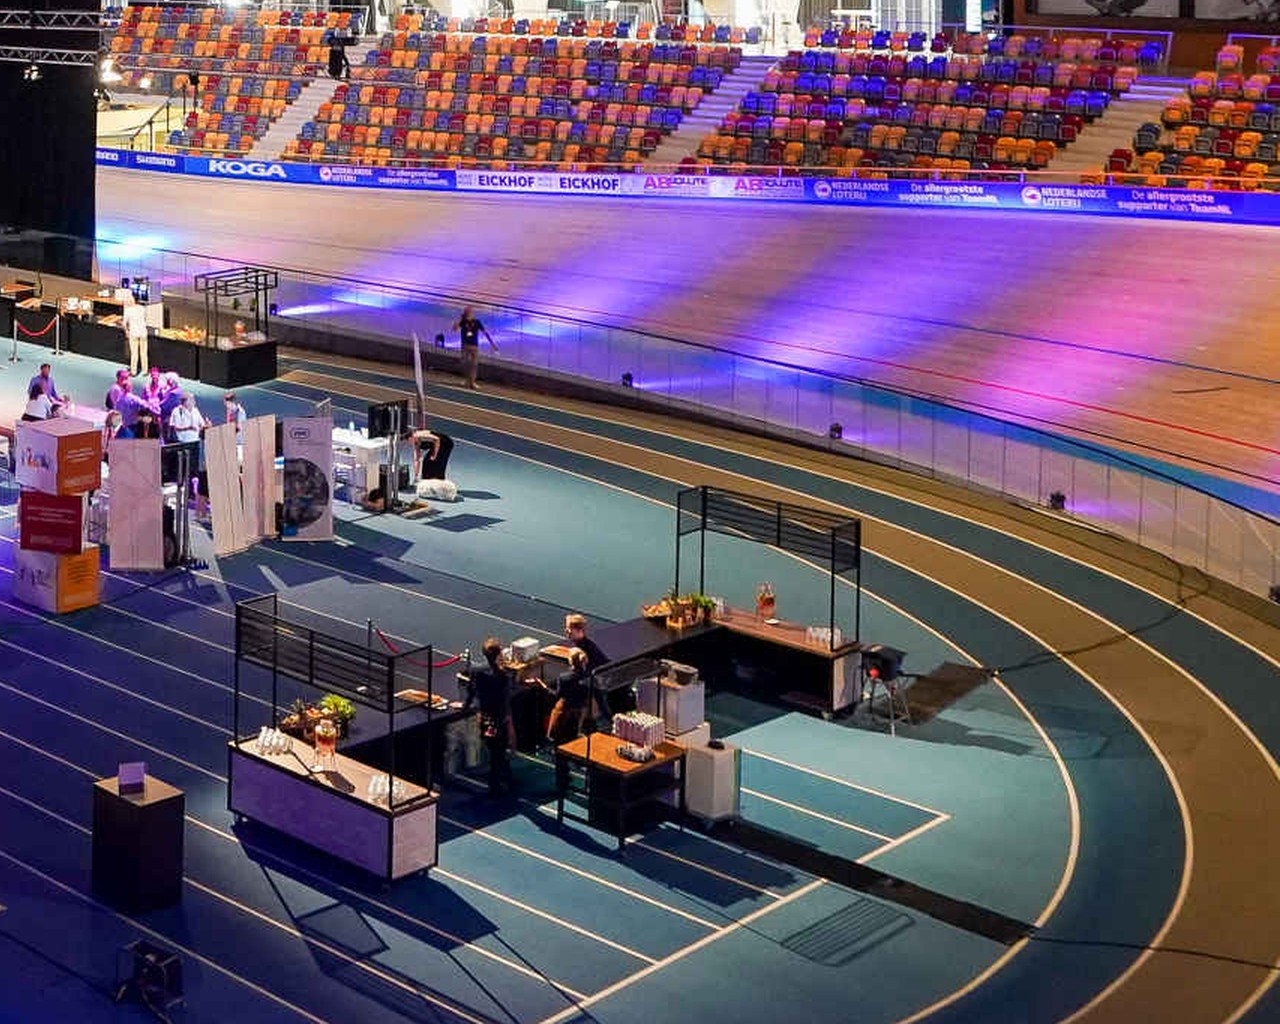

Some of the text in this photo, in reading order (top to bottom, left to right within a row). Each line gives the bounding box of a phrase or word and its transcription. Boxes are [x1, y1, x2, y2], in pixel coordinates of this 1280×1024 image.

[208, 159, 287, 179] KOGA
[478, 175, 536, 188] EICKHOF
[559, 177, 620, 191] EICKHOF
[1041, 187, 1108, 199] NEDERLANDSE
[1147, 191, 1214, 204] allergrootste
[1042, 197, 1081, 209] LOTERIJ
[1118, 200, 1168, 212] supporter
